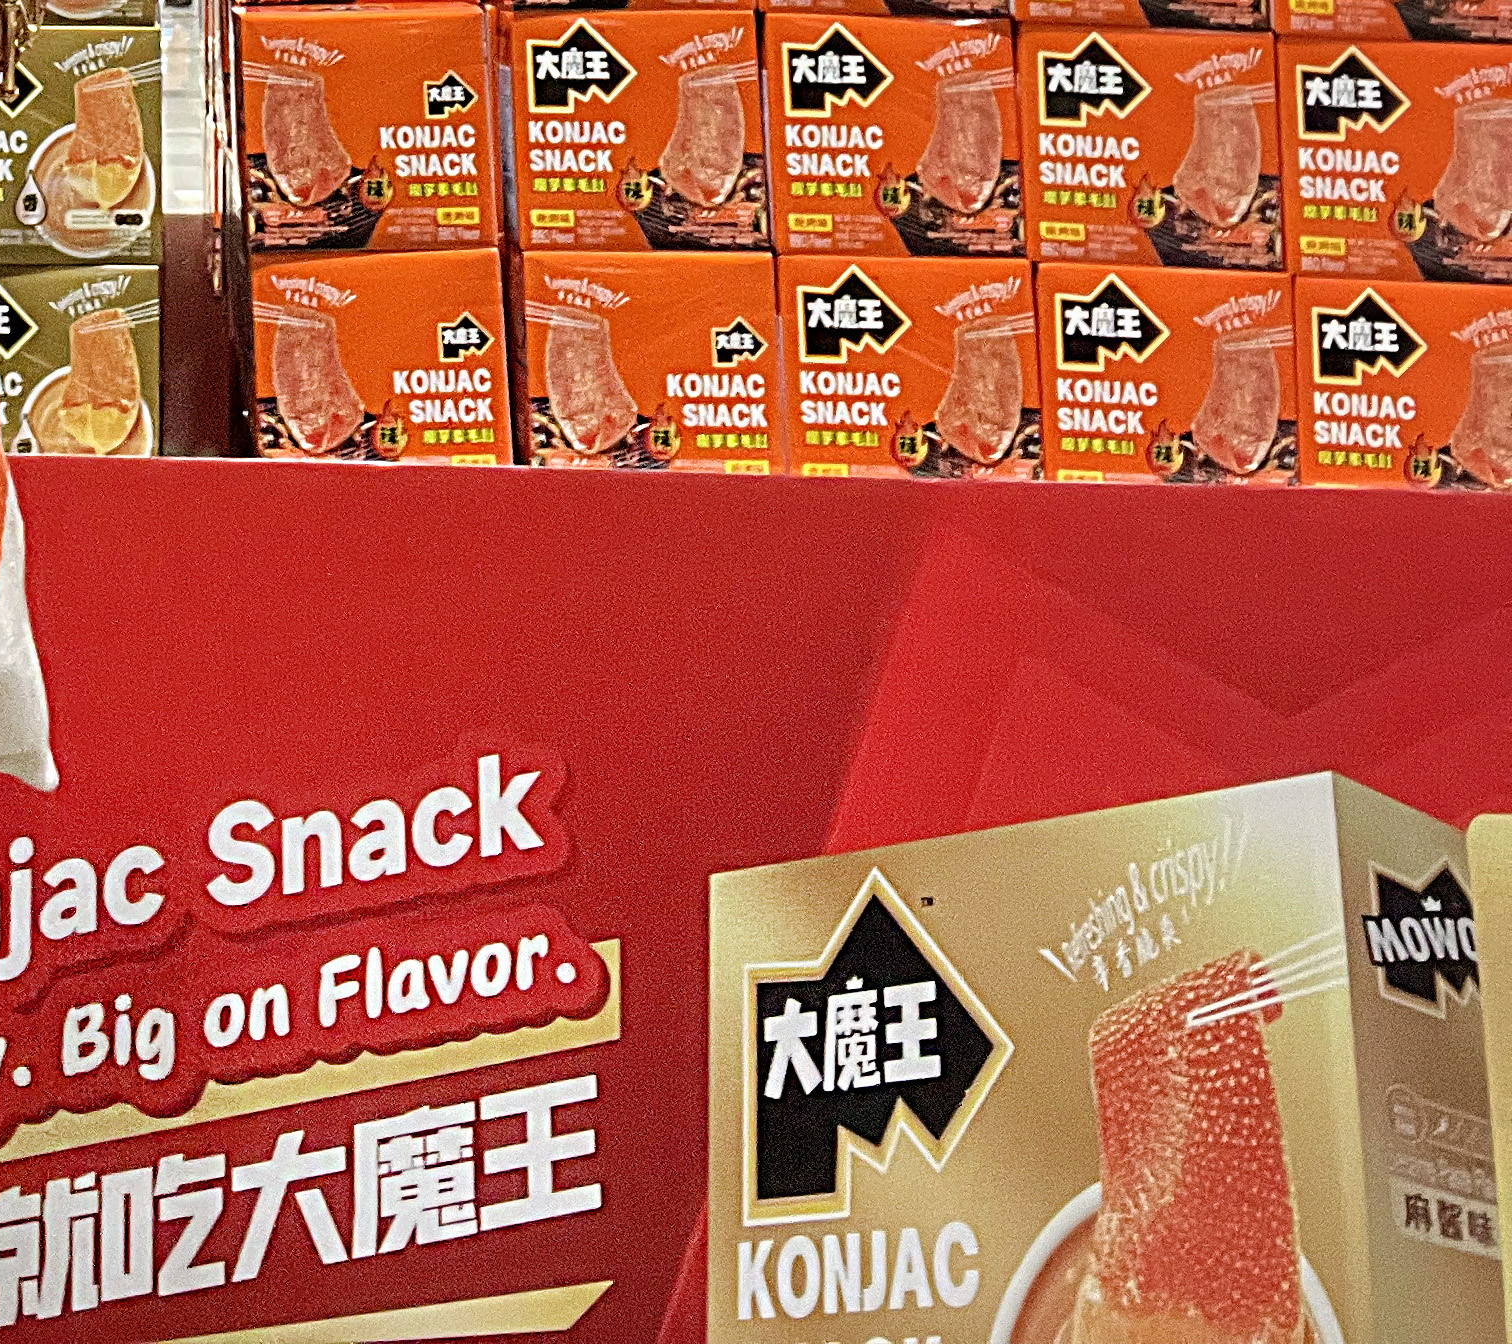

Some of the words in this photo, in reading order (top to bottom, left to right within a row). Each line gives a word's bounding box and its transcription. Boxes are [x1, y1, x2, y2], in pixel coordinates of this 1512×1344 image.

[380, 125, 475, 148] KONJAC
[529, 121, 625, 144] KONJAC
[785, 125, 883, 149] KONJAC
[1040, 133, 1139, 160] KONJAC
[396, 153, 477, 177] SNACK
[530, 149, 612, 172] SNACK
[787, 153, 870, 177] SNACK
[1299, 148, 1399, 174] KONJAC
[1040, 161, 1125, 187] SNACK
[1300, 176, 1385, 202] SNACK
[394, 368, 491, 394] KONJAC
[667, 374, 764, 398] KONJAC
[800, 371, 900, 397] KONJAC
[1057, 378, 1157, 406] KONJAC
[410, 398, 493, 423] SNACK
[683, 403, 767, 427] SNACK
[801, 400, 887, 426] SNACK
[1314, 392, 1416, 420] KONJAC
[1058, 408, 1144, 434] SNACK
[1315, 421, 1402, 447] SNACK
[207, 754, 545, 906] Snack
[62, 995, 176, 1080] Big
[204, 981, 289, 1047] on
[318, 936, 574, 1026] Flavor.
[764, 978, 942, 1099] 大魔王
[737, 1222, 980, 1321] KONJAC
